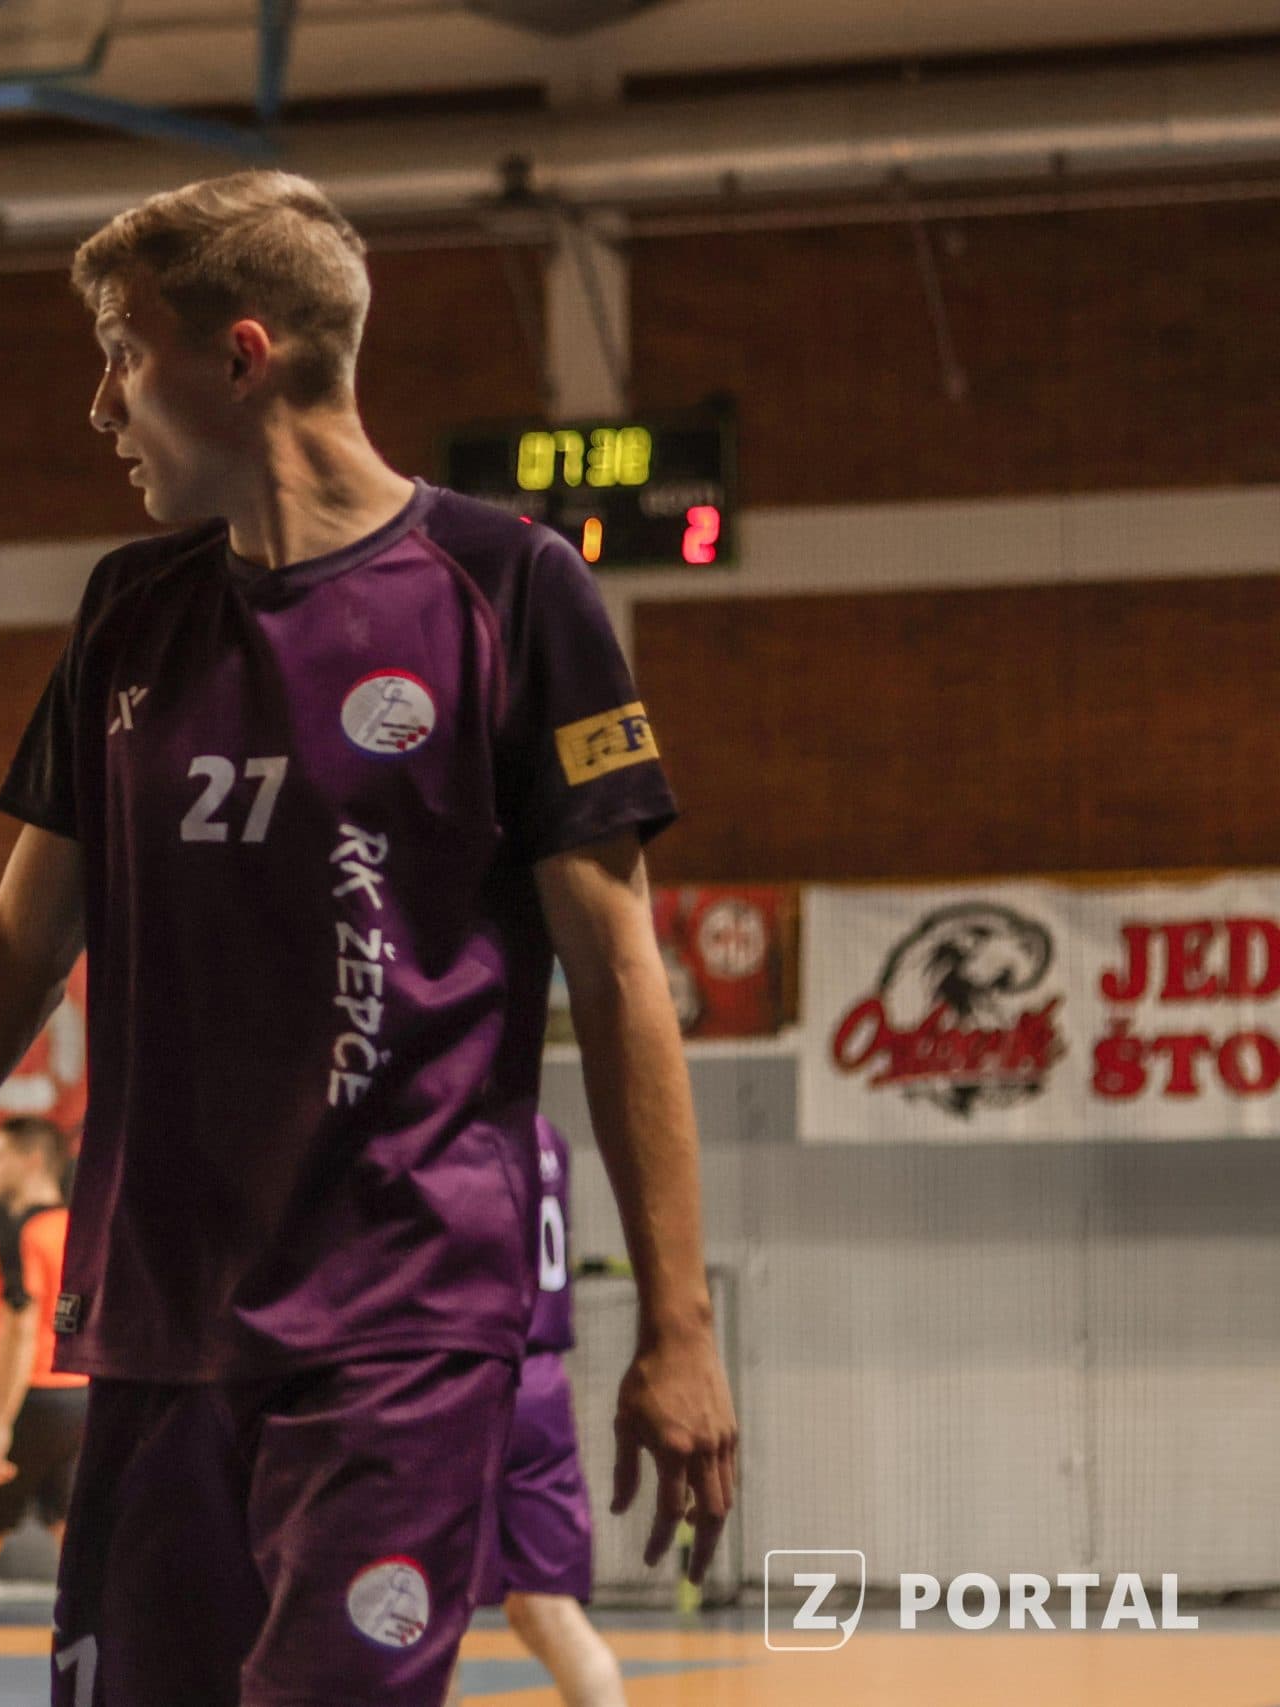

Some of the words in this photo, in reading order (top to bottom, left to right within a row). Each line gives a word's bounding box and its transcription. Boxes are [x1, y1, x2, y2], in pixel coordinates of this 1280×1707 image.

[682, 505, 720, 564] 2
[181, 755, 289, 842] 27
[329, 823, 389, 911] RK
[1101, 919, 1280, 1001] JED
